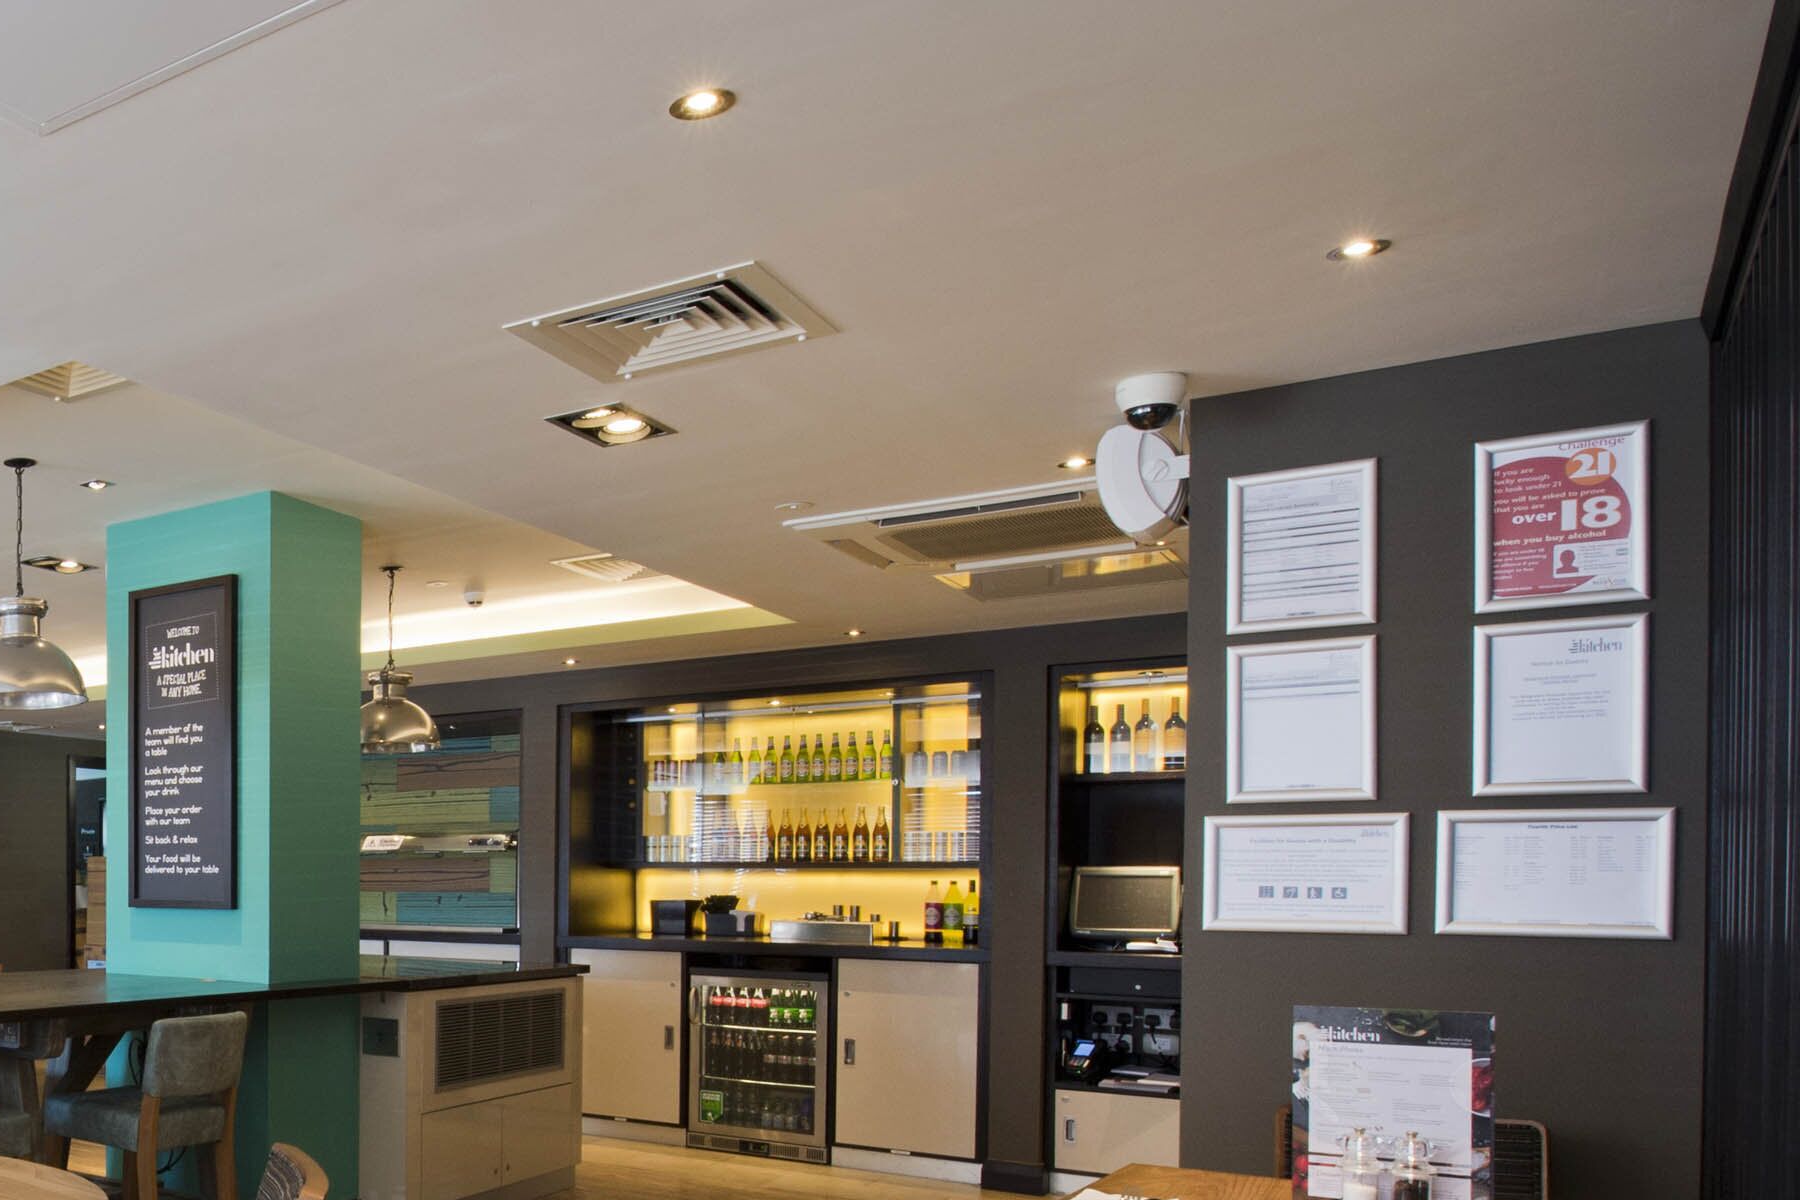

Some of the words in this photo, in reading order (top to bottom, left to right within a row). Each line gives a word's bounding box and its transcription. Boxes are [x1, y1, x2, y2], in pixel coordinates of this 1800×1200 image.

[1568, 451, 1611, 479] 21
[1502, 470, 1519, 478] you
[1517, 474, 1550, 483] enough
[1526, 482, 1551, 491] under
[1551, 480, 1562, 488] 21
[1511, 495, 1527, 503] will
[1528, 493, 1539, 501] be
[1541, 490, 1566, 500] asked
[1580, 488, 1606, 497] prove
[1512, 511, 1557, 525] over
[1561, 496, 1622, 532] 18
[1513, 504, 1529, 513] you
[1494, 538, 1520, 546] when
[1523, 537, 1543, 545] you
[1545, 534, 1565, 543] buy
[1568, 530, 1607, 541] alcohol
[166, 627, 191, 638] WELCOME
[192, 626, 200, 636] TO
[1578, 637, 1623, 653] kitchen
[161, 642, 215, 669] kitchen
[156, 675, 162, 686] A
[162, 673, 187, 686] SPECIAL
[187, 669, 207, 683] PLACE
[168, 686, 182, 698] ANY
[145, 727, 152, 736] A
[152, 725, 182, 735] member
[183, 723, 191, 733] of
[192, 723, 203, 732] the
[145, 738, 162, 746] team
[163, 735, 174, 745] will
[175, 734, 188, 744] find
[190, 735, 203, 745] you
[151, 747, 168, 756] table
[145, 766, 161, 776] Look
[162, 764, 189, 776] through
[190, 765, 203, 773] our
[164, 775, 178, 785] and
[178, 775, 203, 784] choose
[145, 789, 160, 799] your
[161, 786, 180, 796] drink
[145, 806, 163, 815] Place
[164, 807, 180, 817] your
[181, 804, 203, 814] order
[145, 817, 158, 826] with
[172, 817, 190, 825] team
[145, 835, 153, 845] Sit
[155, 835, 171, 845] back
[172, 835, 179, 844] &
[180, 834, 198, 844] relax
[145, 854, 161, 863] Your
[162, 854, 179, 863] food
[179, 854, 191, 863] will
[191, 854, 201, 863] be
[145, 865, 175, 874] delivered
[176, 866, 184, 874] to
[184, 867, 201, 876] your
[201, 865, 220, 874] table
[1328, 1025, 1381, 1043] kitchen
